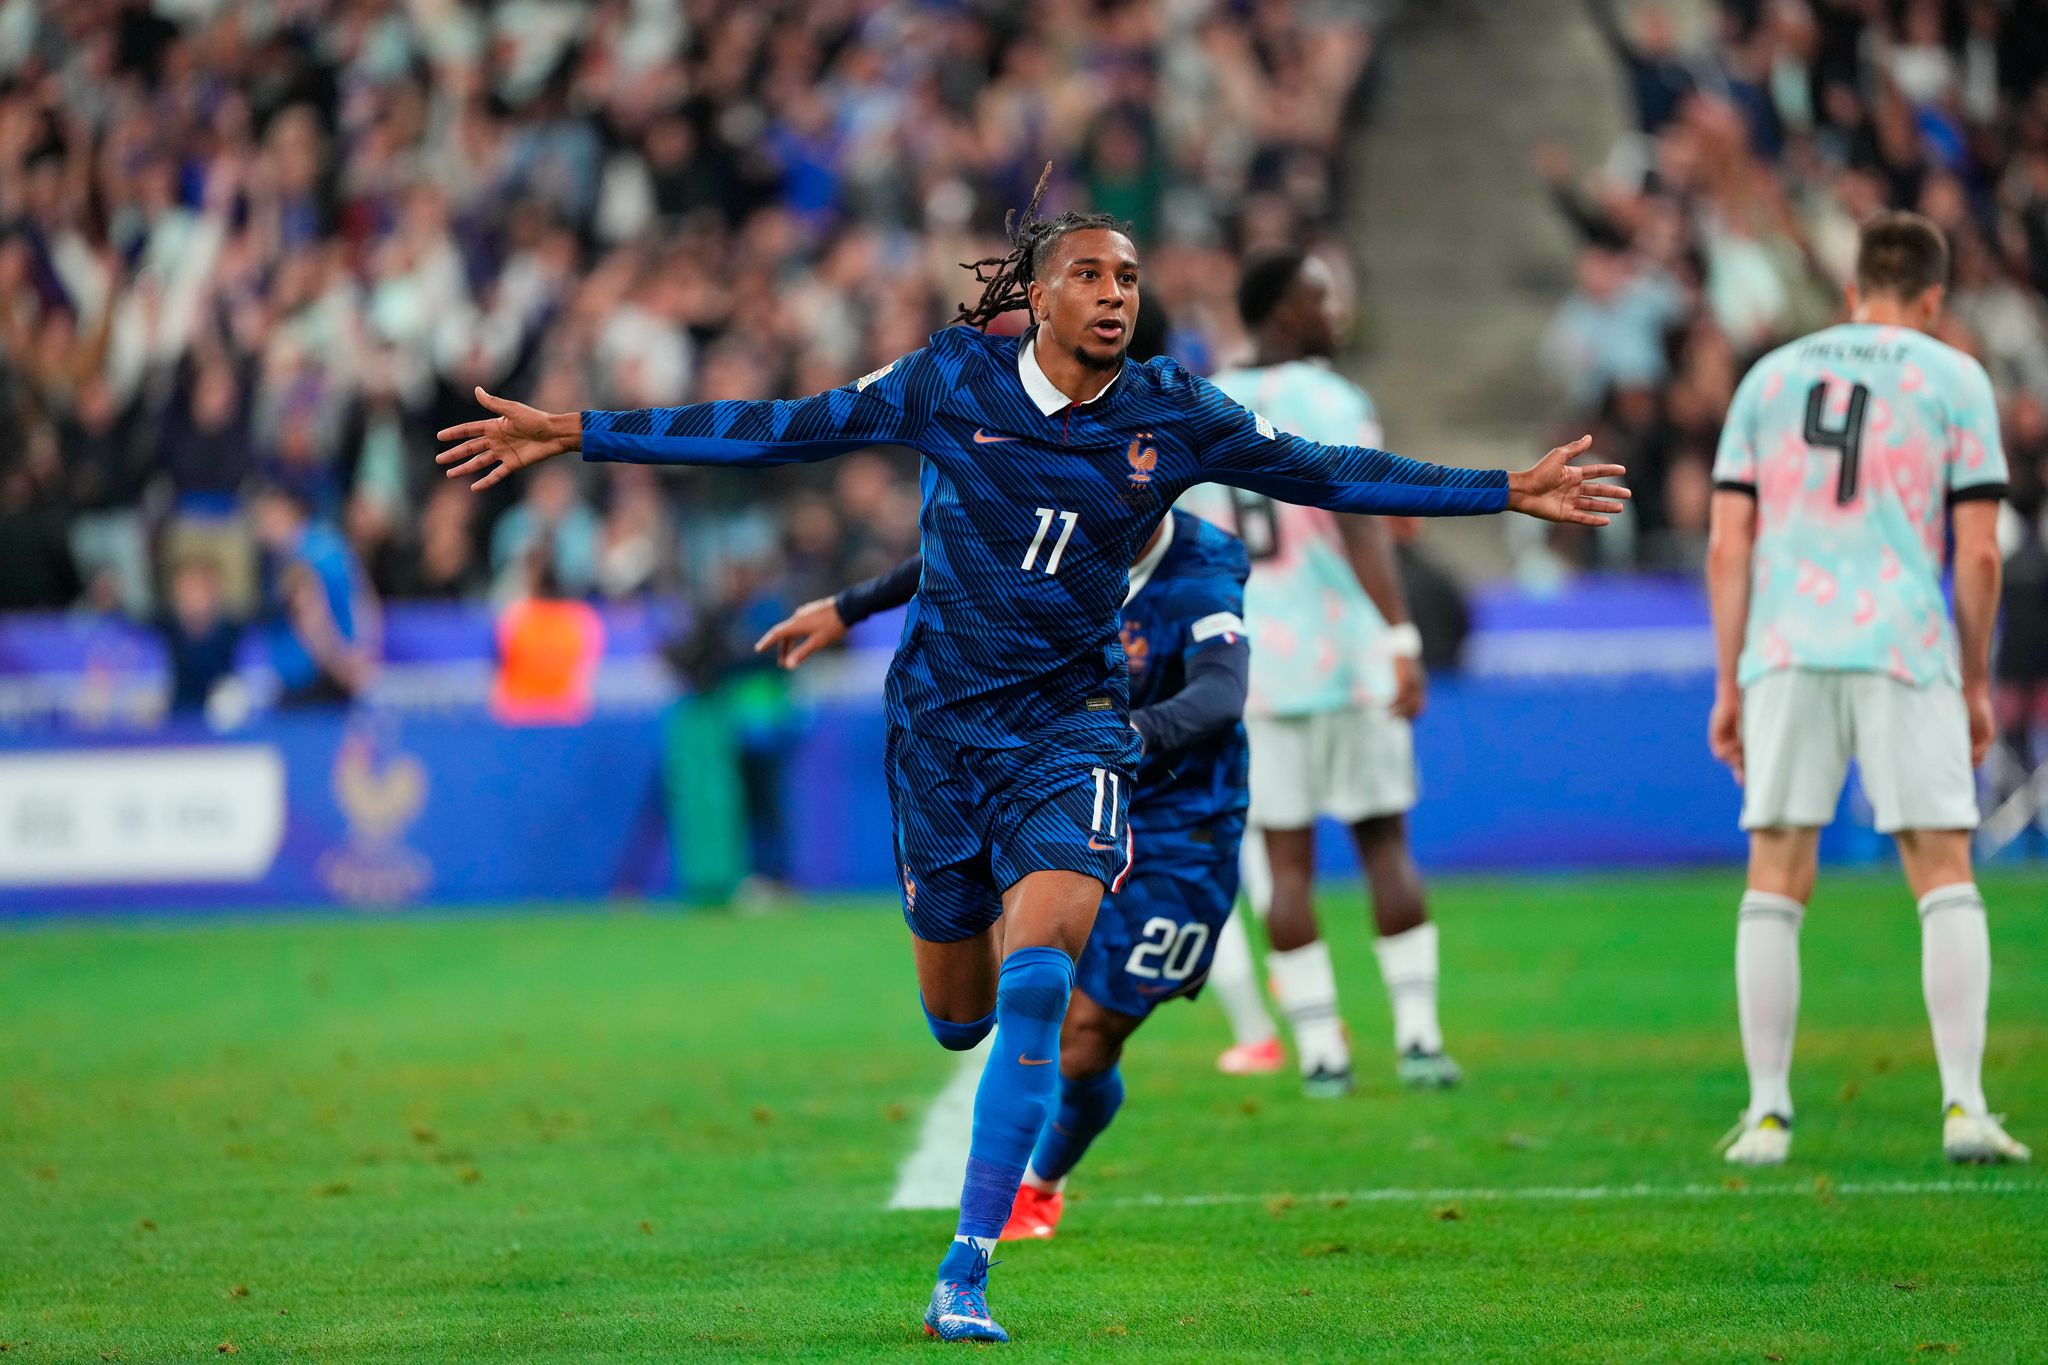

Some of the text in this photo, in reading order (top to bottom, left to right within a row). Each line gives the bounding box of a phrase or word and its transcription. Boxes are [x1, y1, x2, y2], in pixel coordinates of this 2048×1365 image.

[1803, 380, 1869, 507] 4
[1020, 507, 1079, 575] 11
[1091, 767, 1119, 838] 11
[1124, 916, 1210, 981] 20
